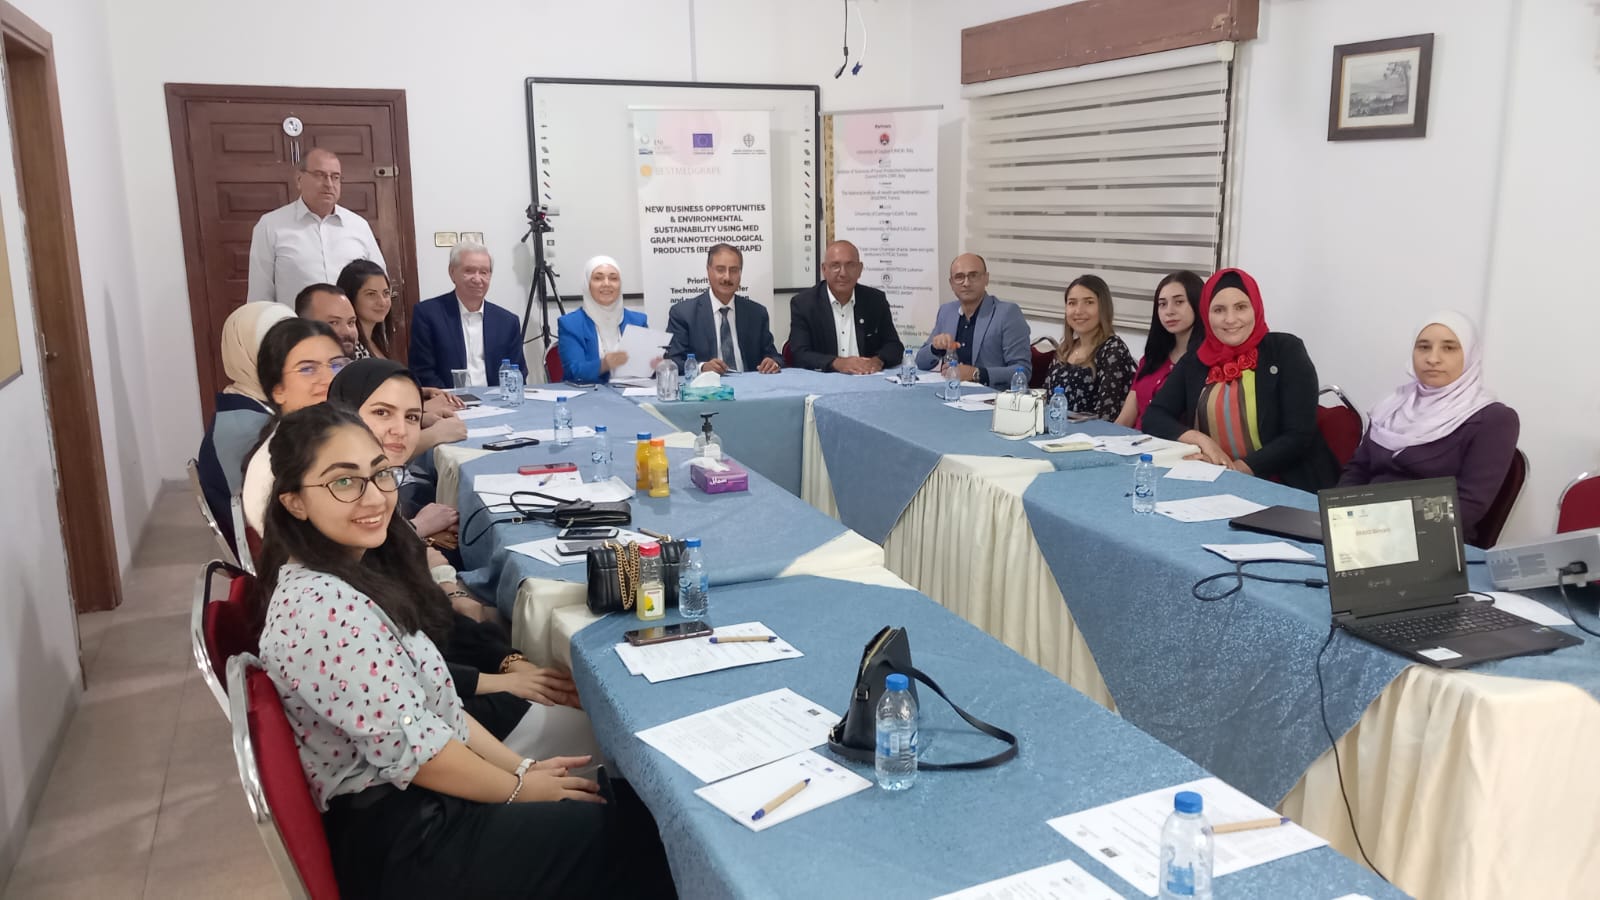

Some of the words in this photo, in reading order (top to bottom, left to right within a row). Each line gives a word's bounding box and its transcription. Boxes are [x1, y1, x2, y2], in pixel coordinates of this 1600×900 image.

[645, 205, 664, 213] NEW
[665, 204, 704, 213] BUSINESS
[705, 204, 766, 212] OPPORTUNITIES
[677, 215, 743, 223] ENVIRONMENTAL
[653, 225, 717, 233] SUSTAINABILITY
[677, 235, 764, 243] NANOTECHNOLOGICAL
[653, 246, 695, 254] PRODUCTS
